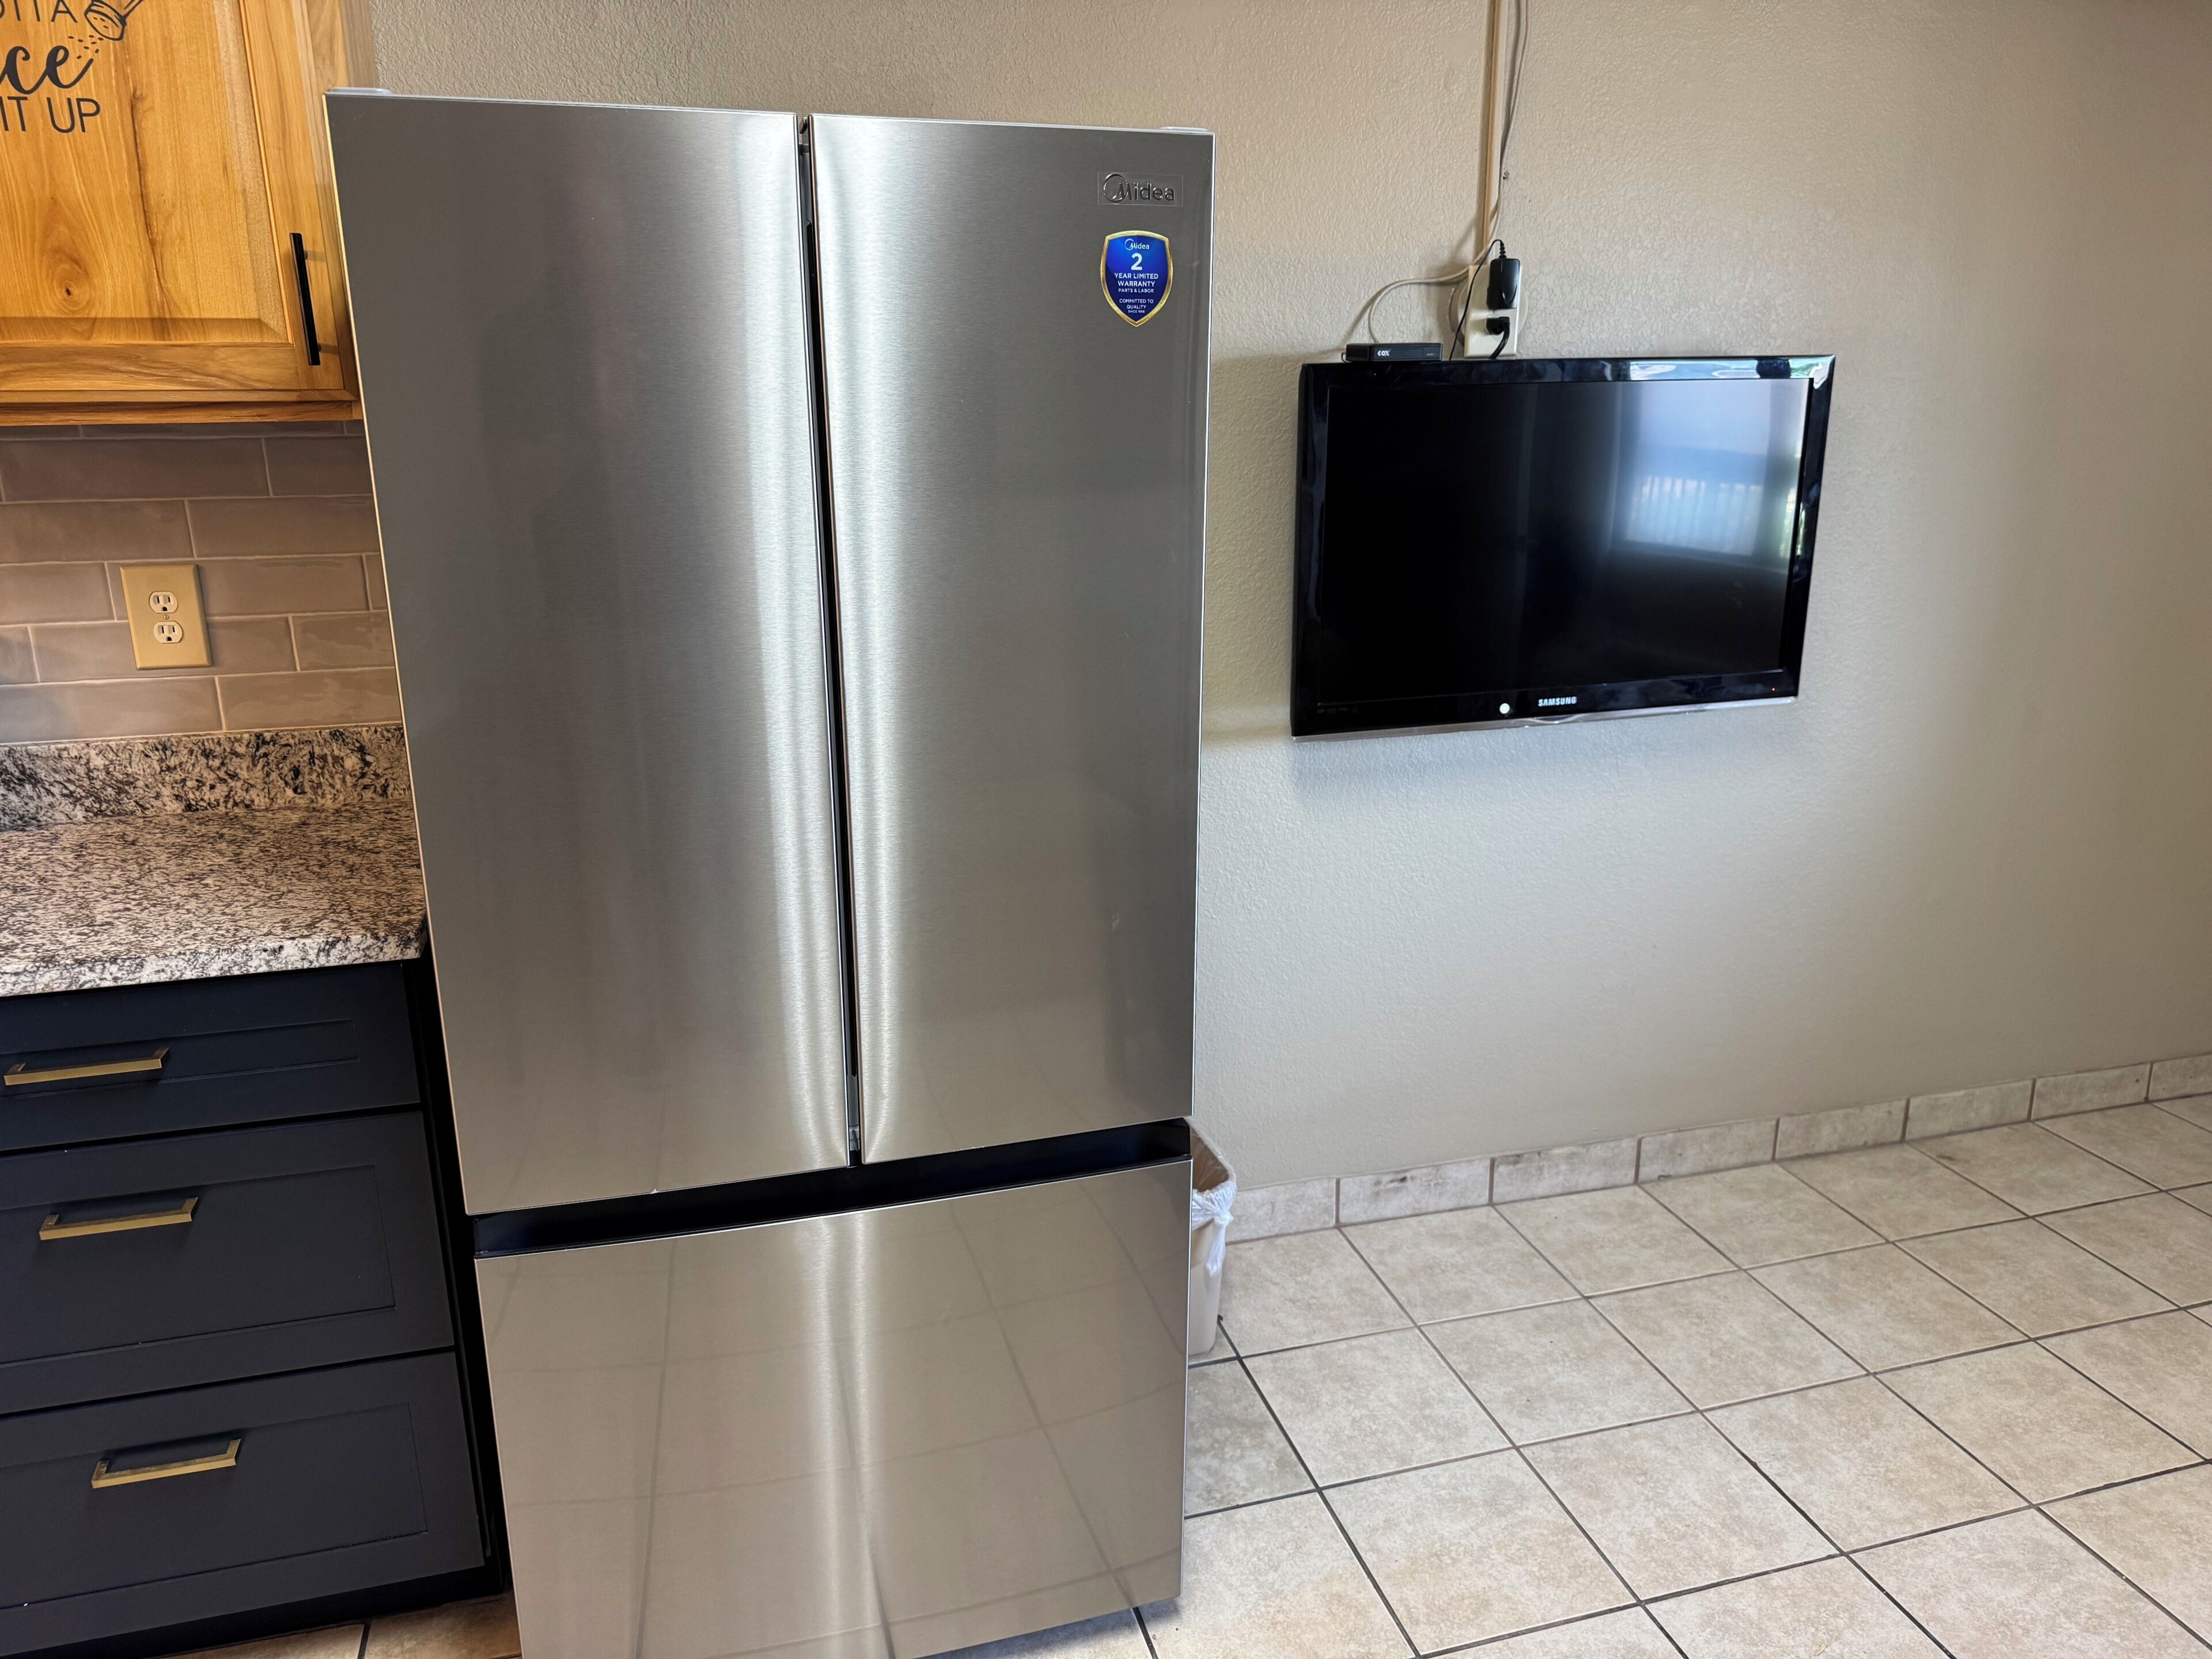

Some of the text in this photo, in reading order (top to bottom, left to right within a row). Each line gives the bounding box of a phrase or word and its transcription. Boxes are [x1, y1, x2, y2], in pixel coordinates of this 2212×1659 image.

[0, 96, 100, 133] IT UP
[1103, 173, 1175, 203] Midea
[1124, 238, 1150, 251] Midea
[1131, 252, 1143, 271] 2
[1537, 696, 1578, 707] SAMSUNG
